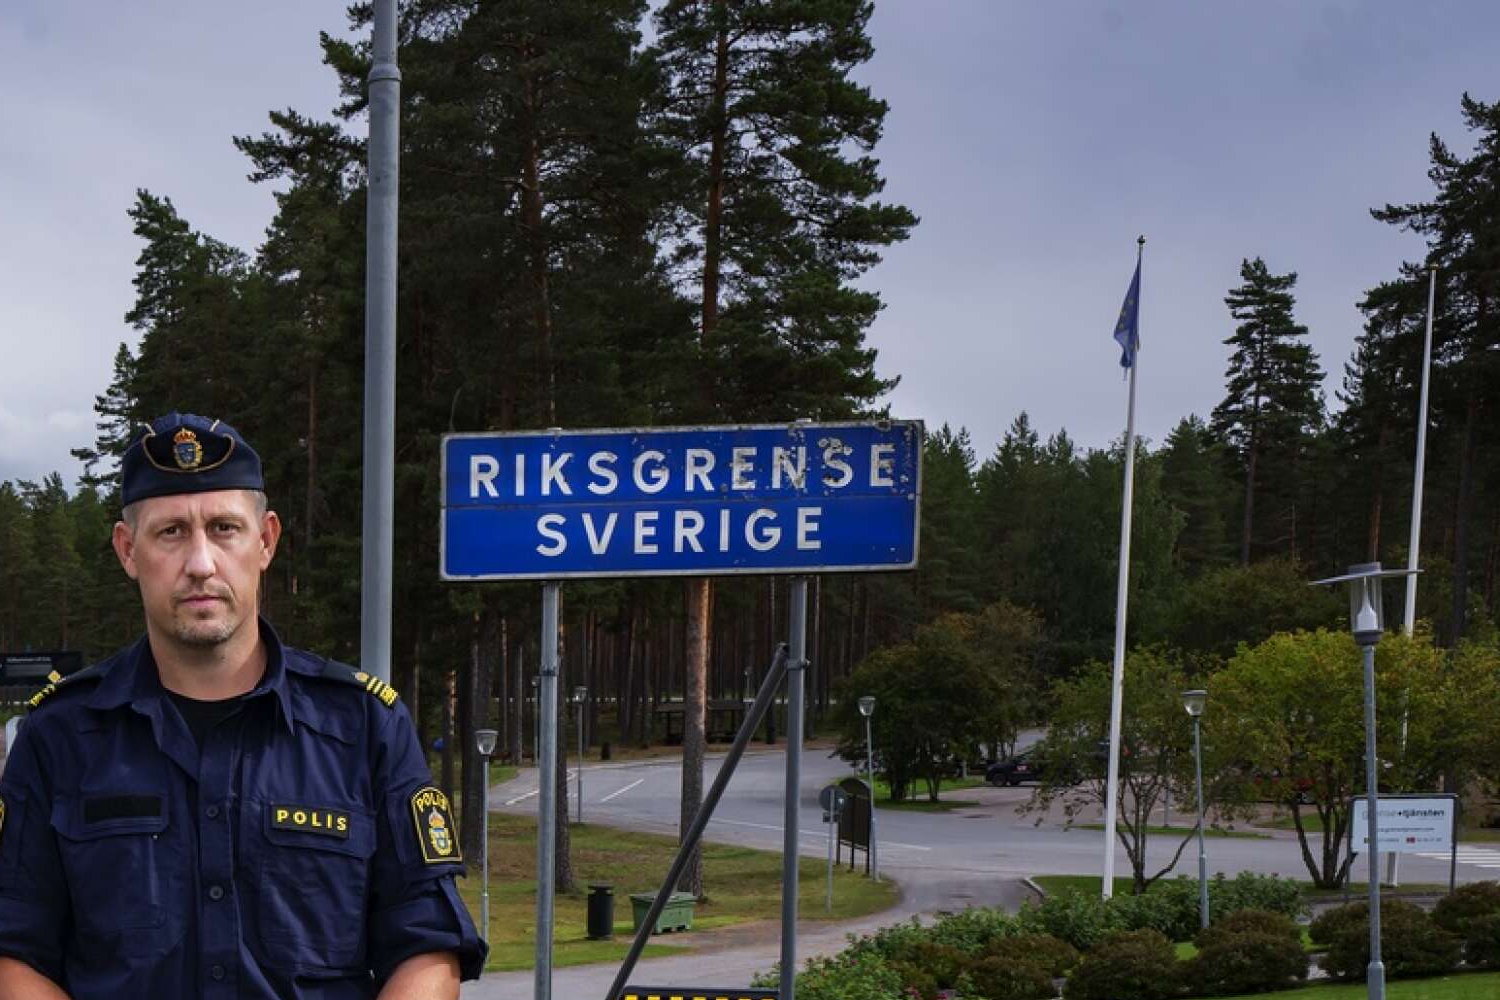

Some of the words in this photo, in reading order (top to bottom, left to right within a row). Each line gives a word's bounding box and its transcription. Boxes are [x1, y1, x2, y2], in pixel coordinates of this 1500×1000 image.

[469, 443, 897, 499] RIKSGRENSE
[536, 506, 822, 557] SVERIGE
[275, 809, 347, 831] POLIS
